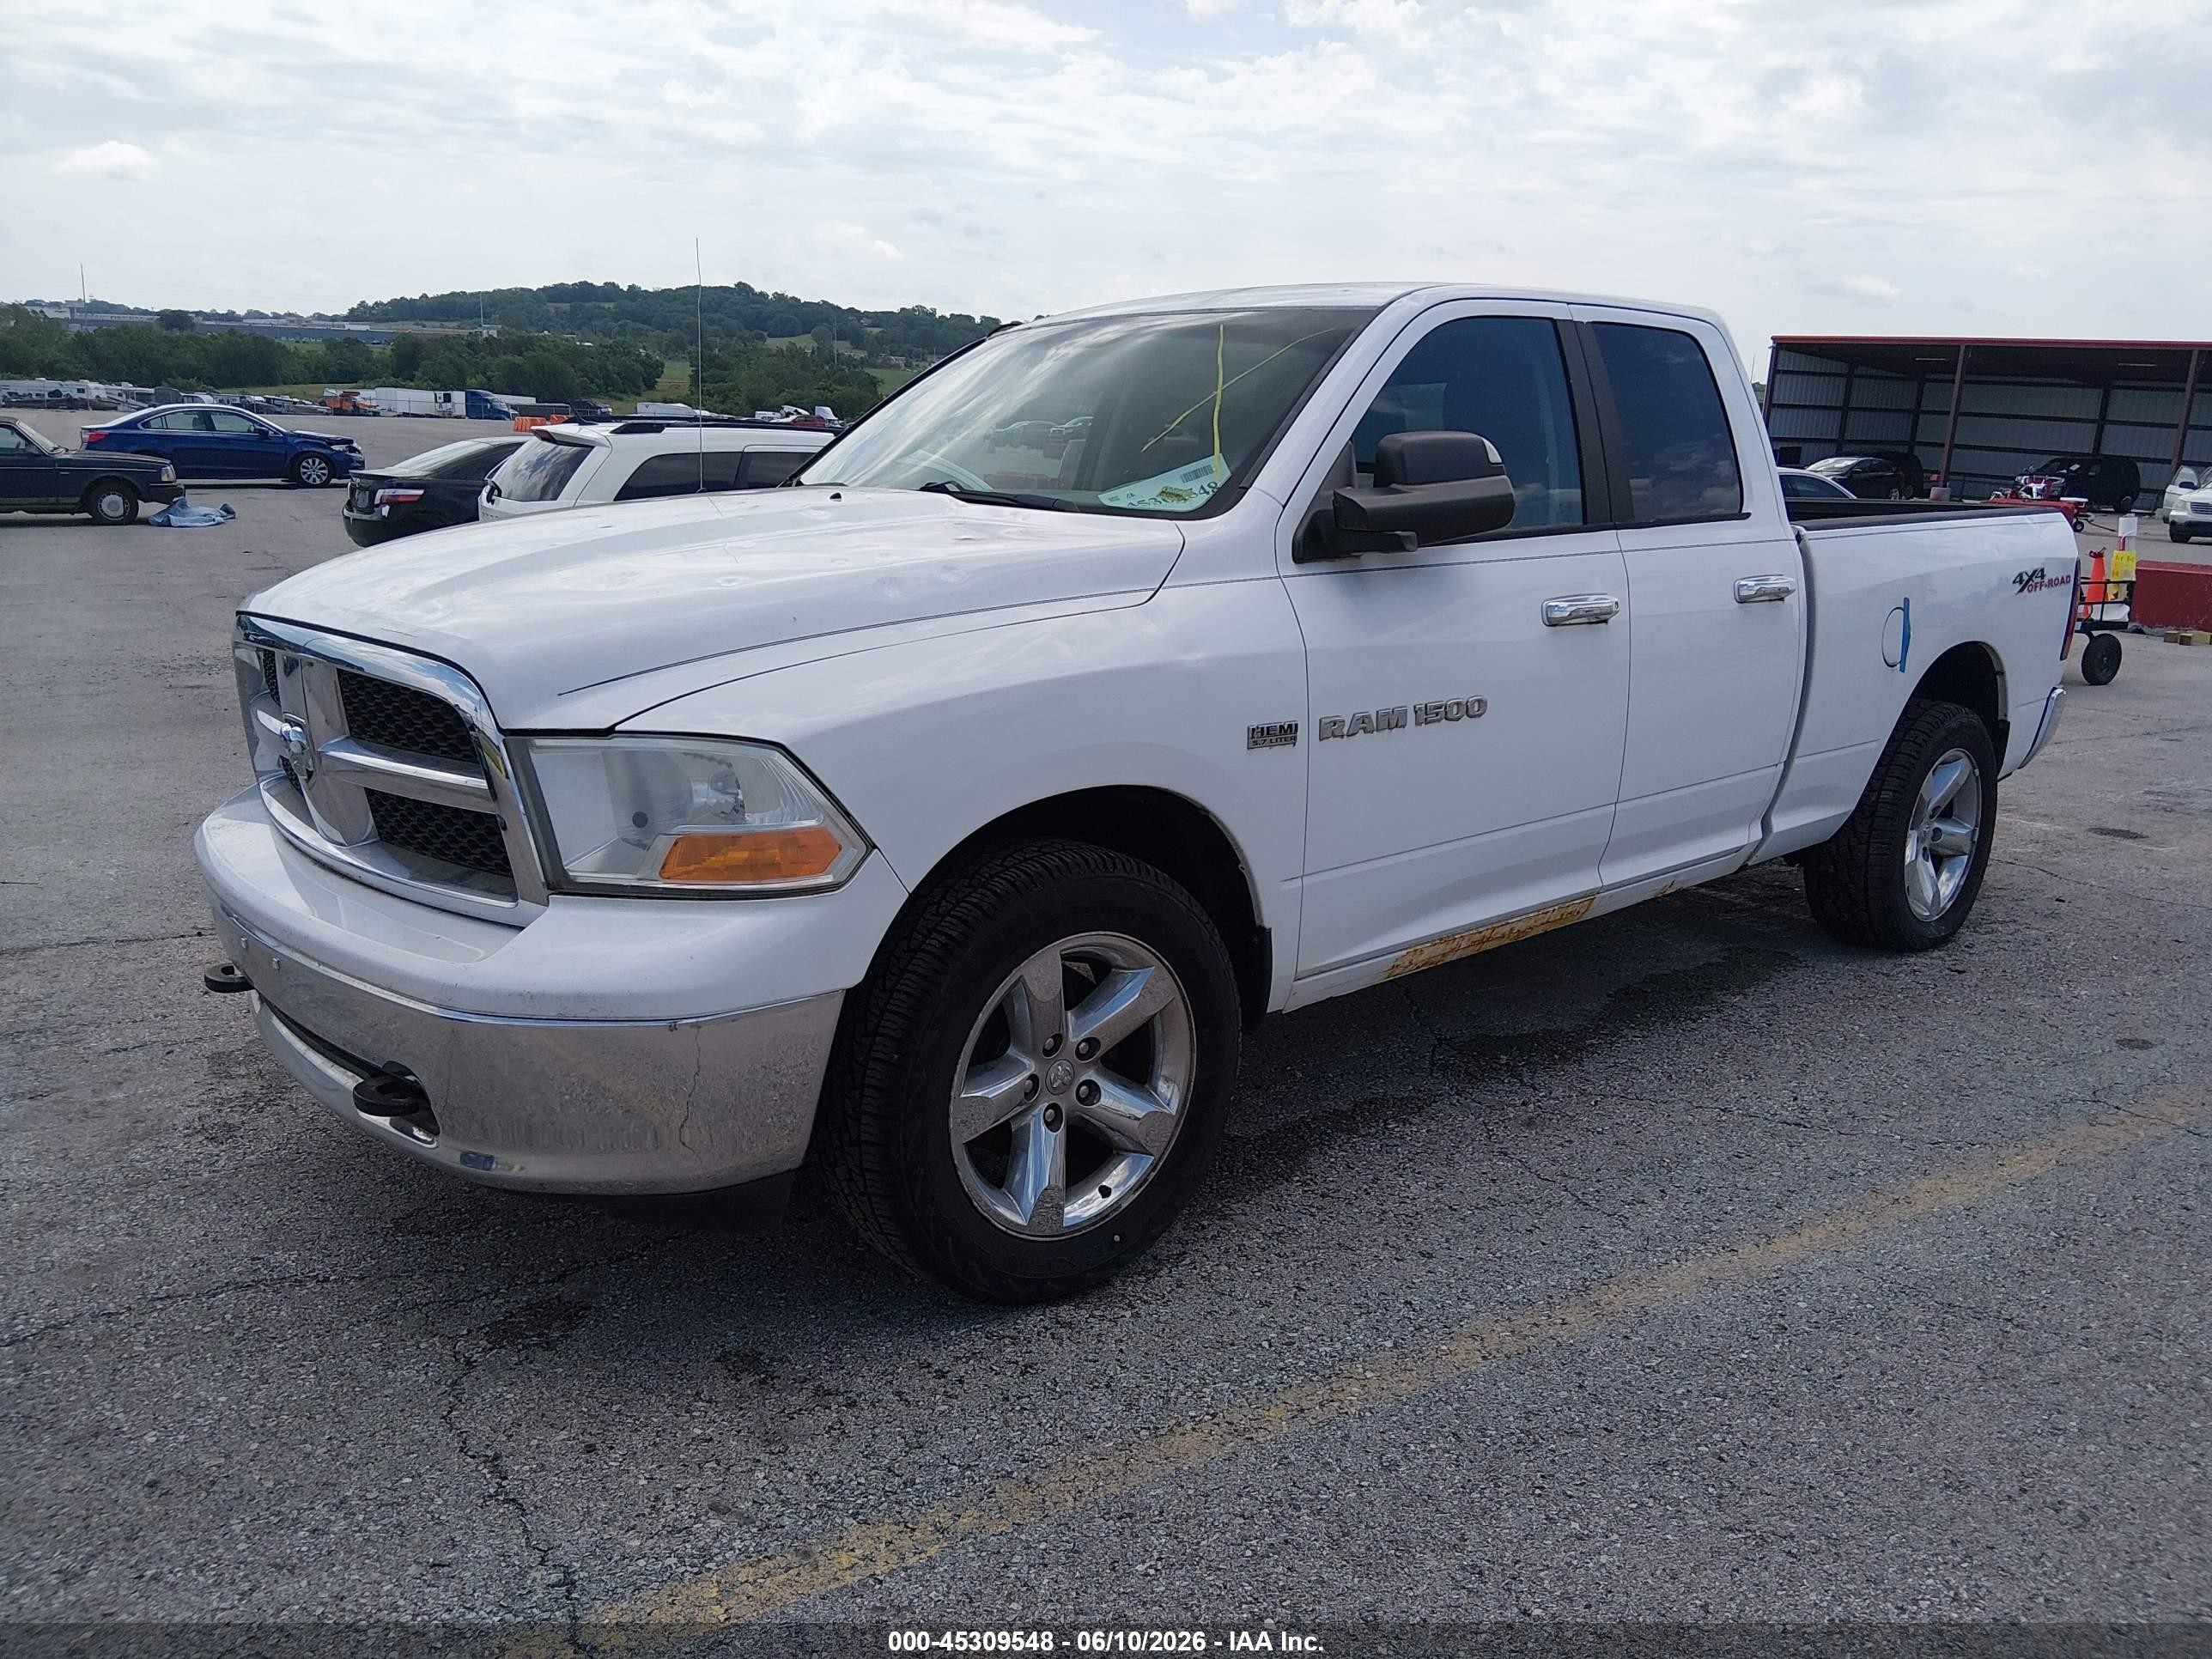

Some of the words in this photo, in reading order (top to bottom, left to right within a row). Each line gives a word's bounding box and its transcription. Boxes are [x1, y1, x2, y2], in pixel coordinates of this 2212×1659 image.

[2027, 575, 2071, 593] OFF-ROAD
[1319, 706, 1407, 742] RAM
[1413, 695, 1488, 726] 1500
[1250, 722, 1298, 739] HEMI
[1269, 736, 1297, 744] LITER
